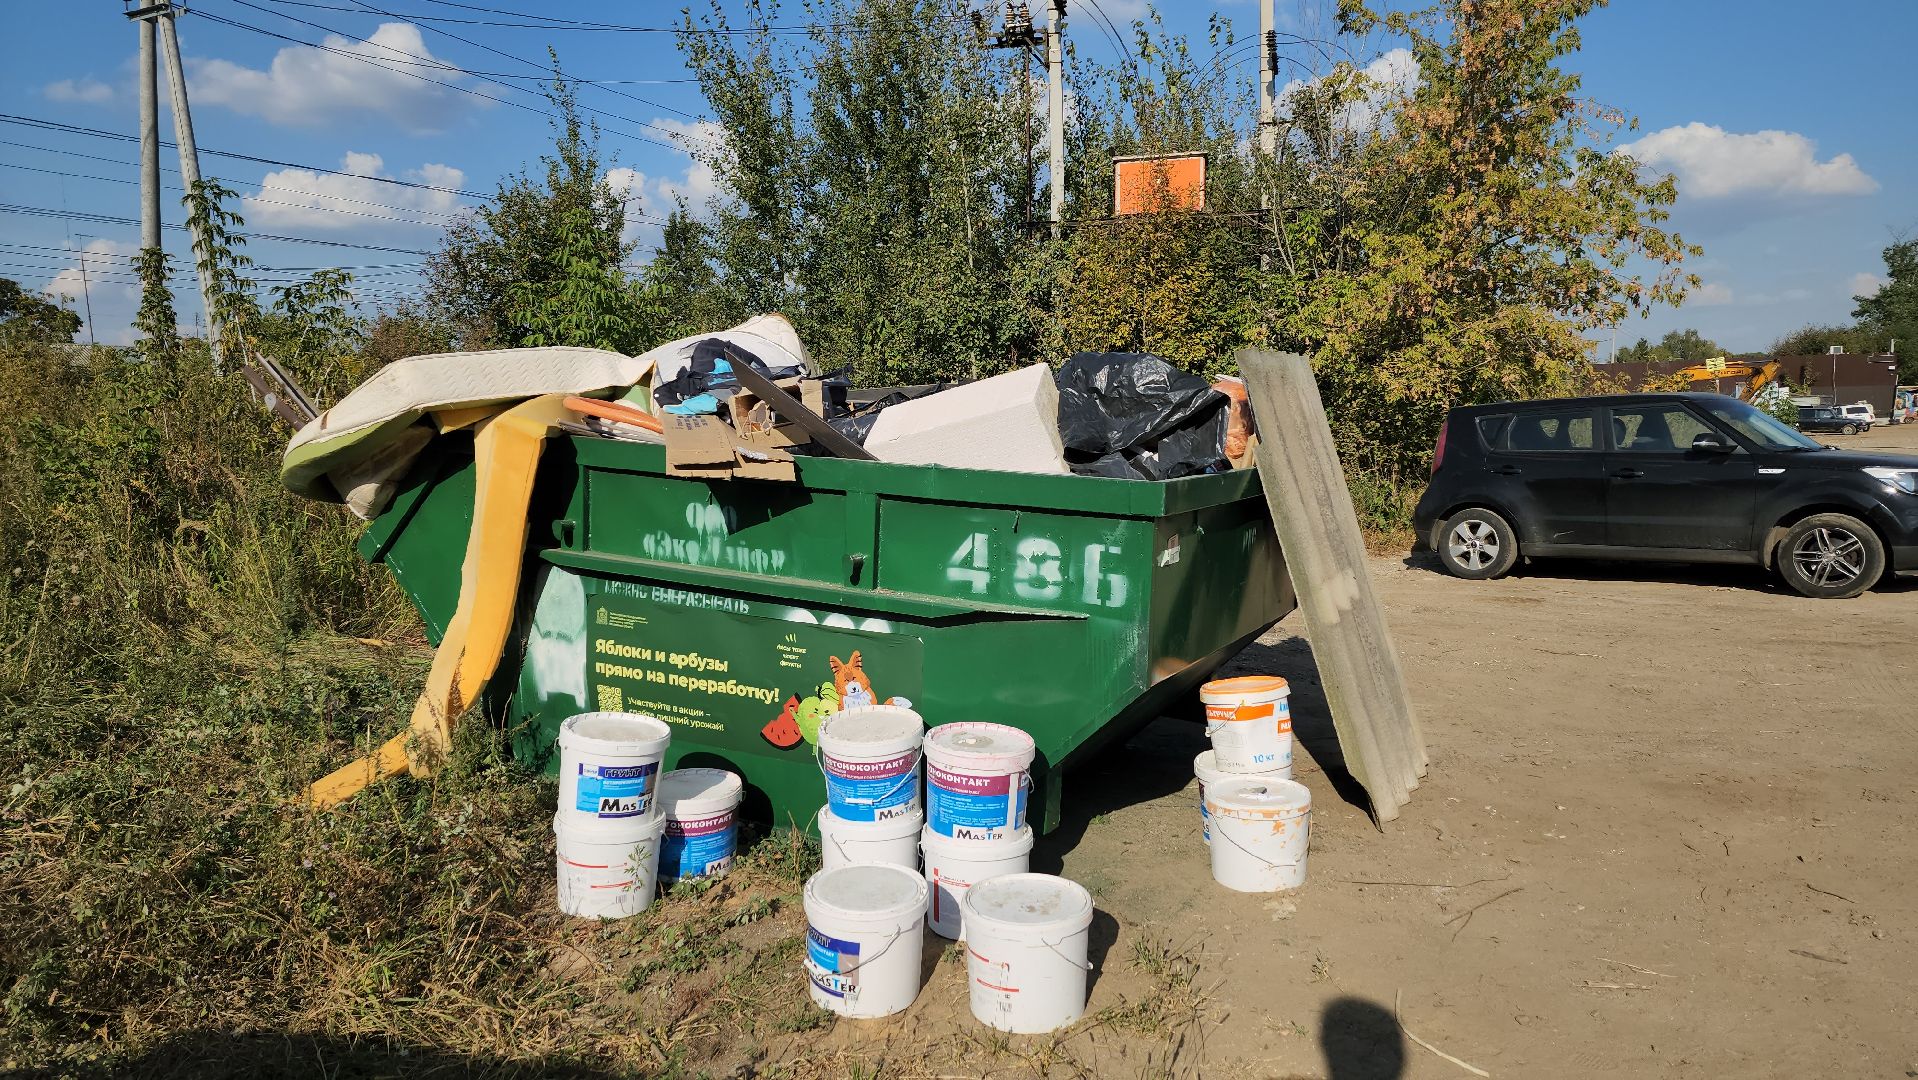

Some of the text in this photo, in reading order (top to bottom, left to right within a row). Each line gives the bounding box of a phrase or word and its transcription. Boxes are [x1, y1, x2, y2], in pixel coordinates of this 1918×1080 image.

[946, 532, 1128, 608] 486
[595, 639, 729, 673] Яблоки и арбузы
[595, 661, 780, 705] прямо на переработку!
[627, 696, 671, 713] Участвуйте
[672, 705, 679, 713] в
[678, 706, 704, 718] акции
[656, 713, 690, 726] лишний
[689, 718, 725, 732] урожай!
[1253, 754, 1264, 764] 10
[604, 768, 642, 778] ГРУНТ
